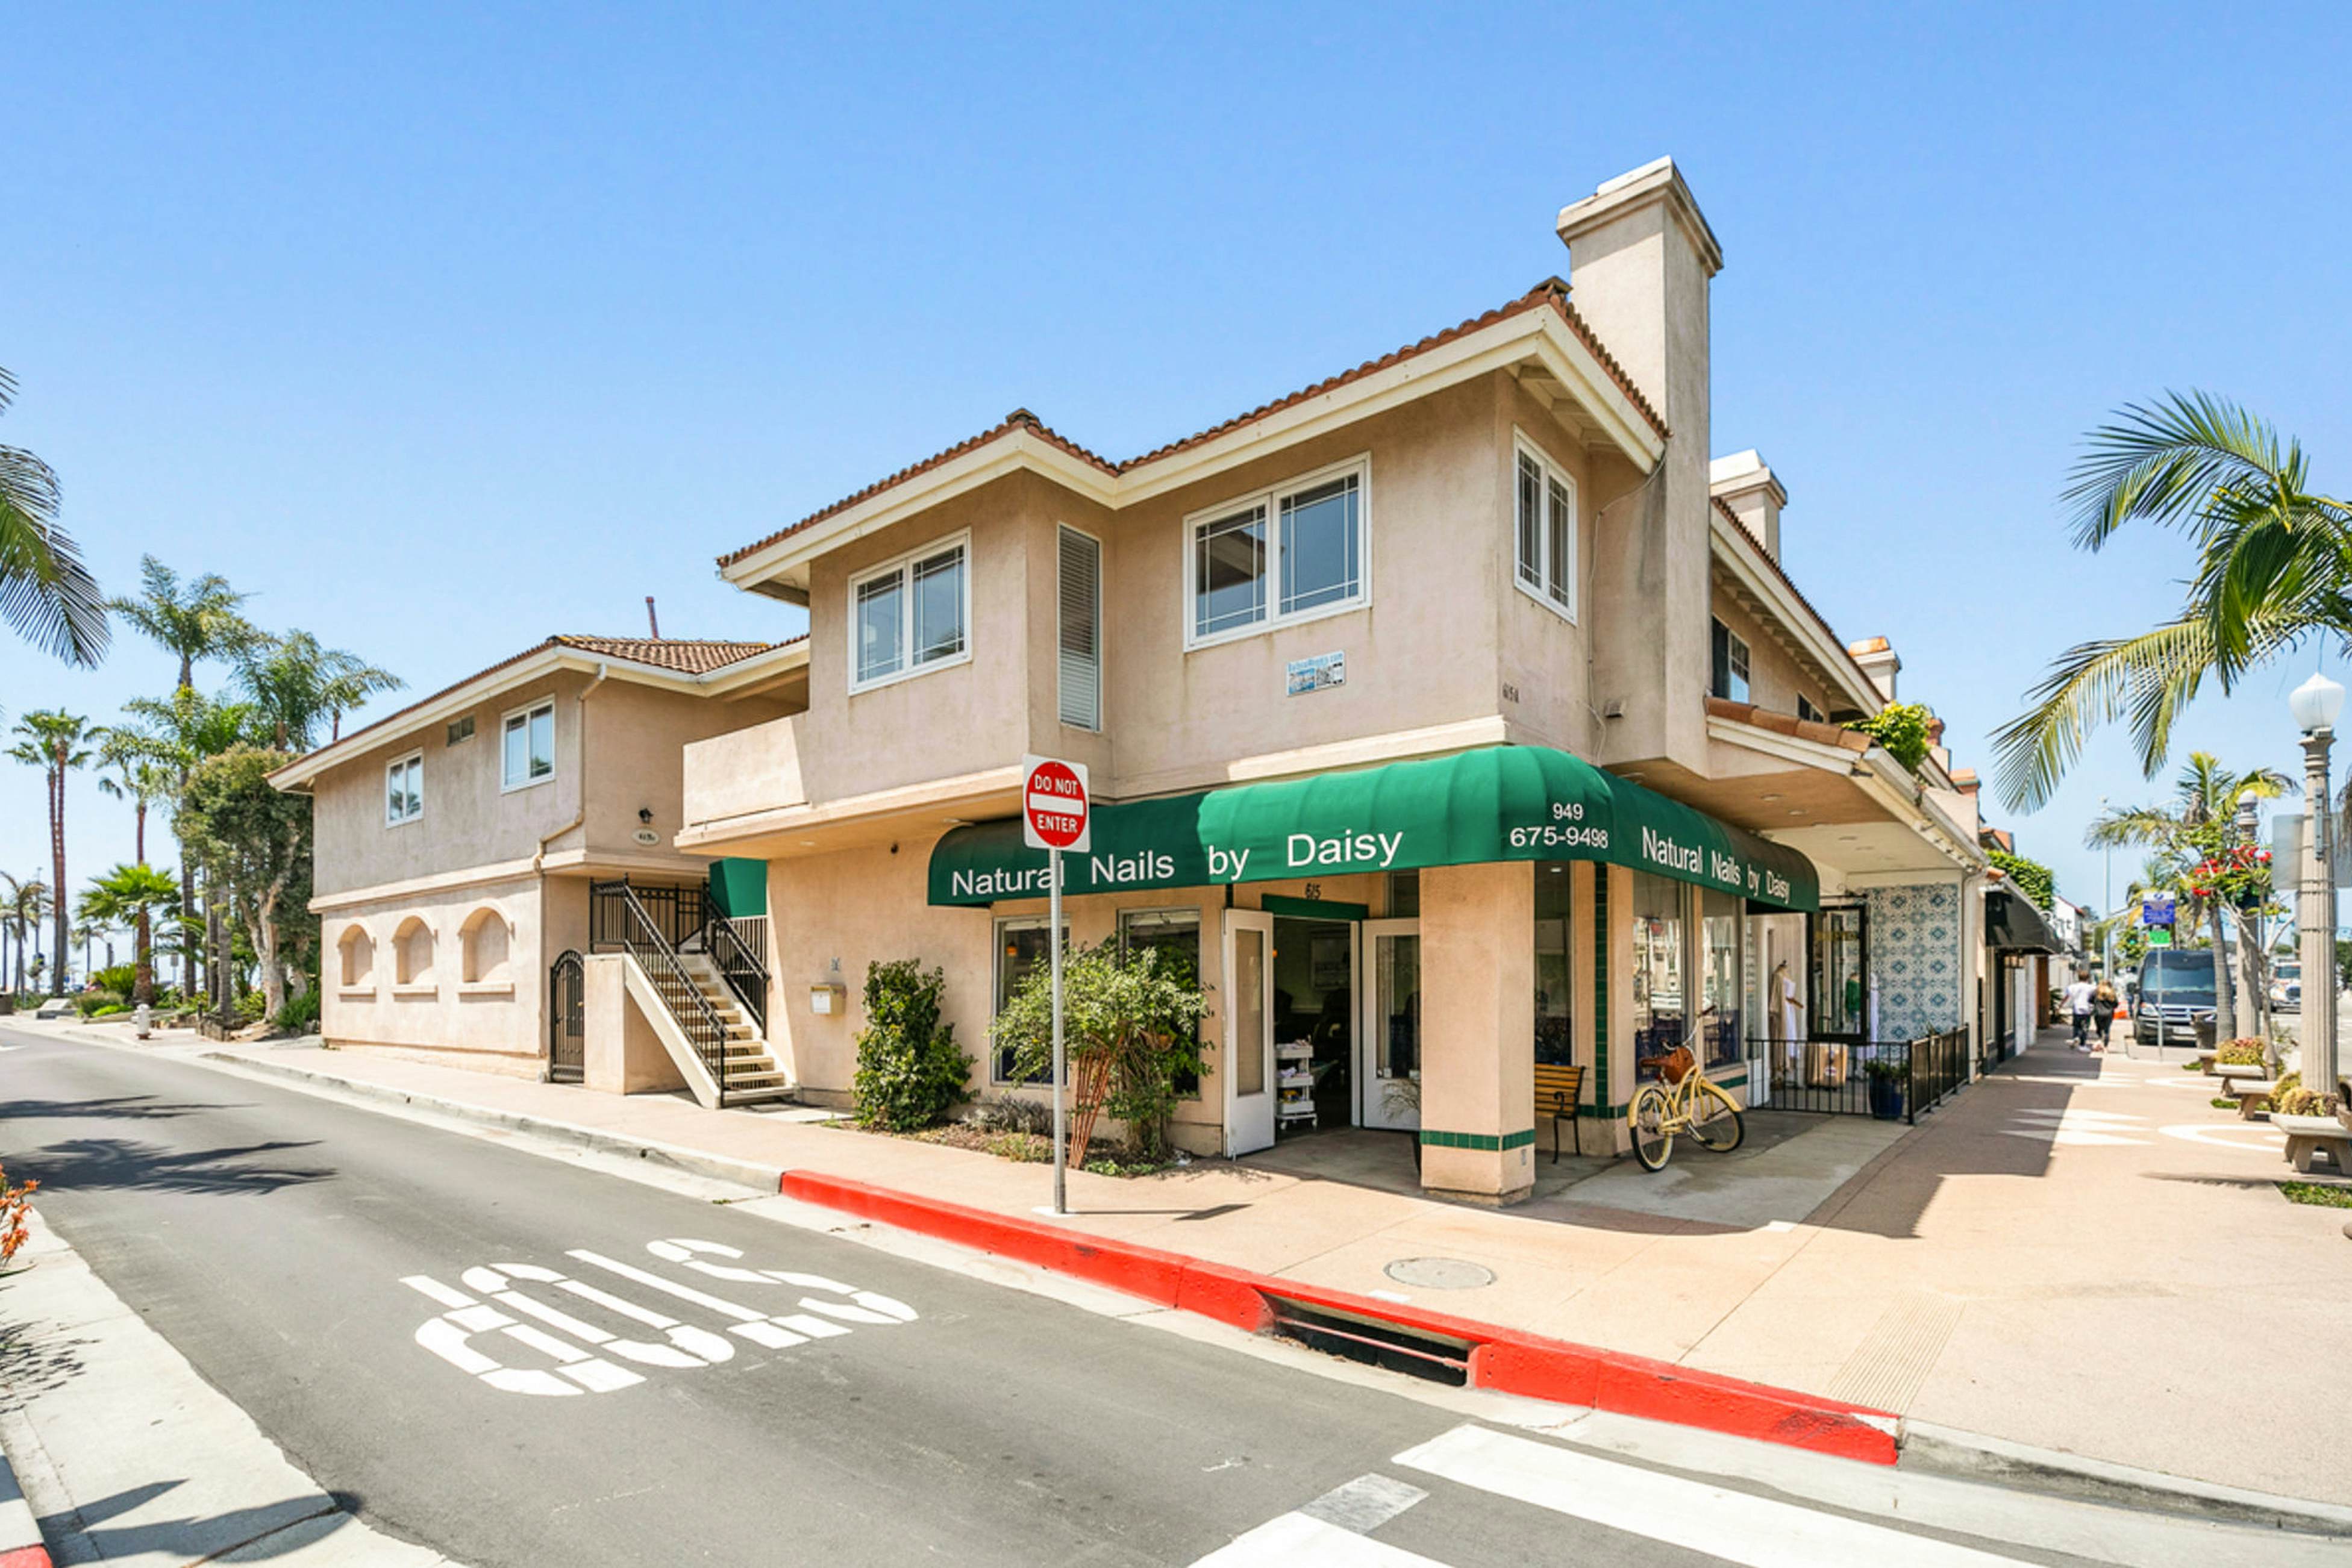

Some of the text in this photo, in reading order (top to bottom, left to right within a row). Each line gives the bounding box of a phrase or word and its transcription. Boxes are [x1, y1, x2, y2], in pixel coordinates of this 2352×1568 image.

[1034, 774, 1078, 795] DO NOT
[1553, 802, 1584, 820] 949
[1037, 813, 1078, 834] ENTER
[1509, 825, 1609, 849] 675-9498
[1091, 849, 1175, 885] Nails
[1208, 845, 1250, 881] by
[1287, 828, 1404, 867] Daisy
[1642, 825, 1791, 905] Natural Nails by Daisy
[398, 1238, 921, 1397] STOP
